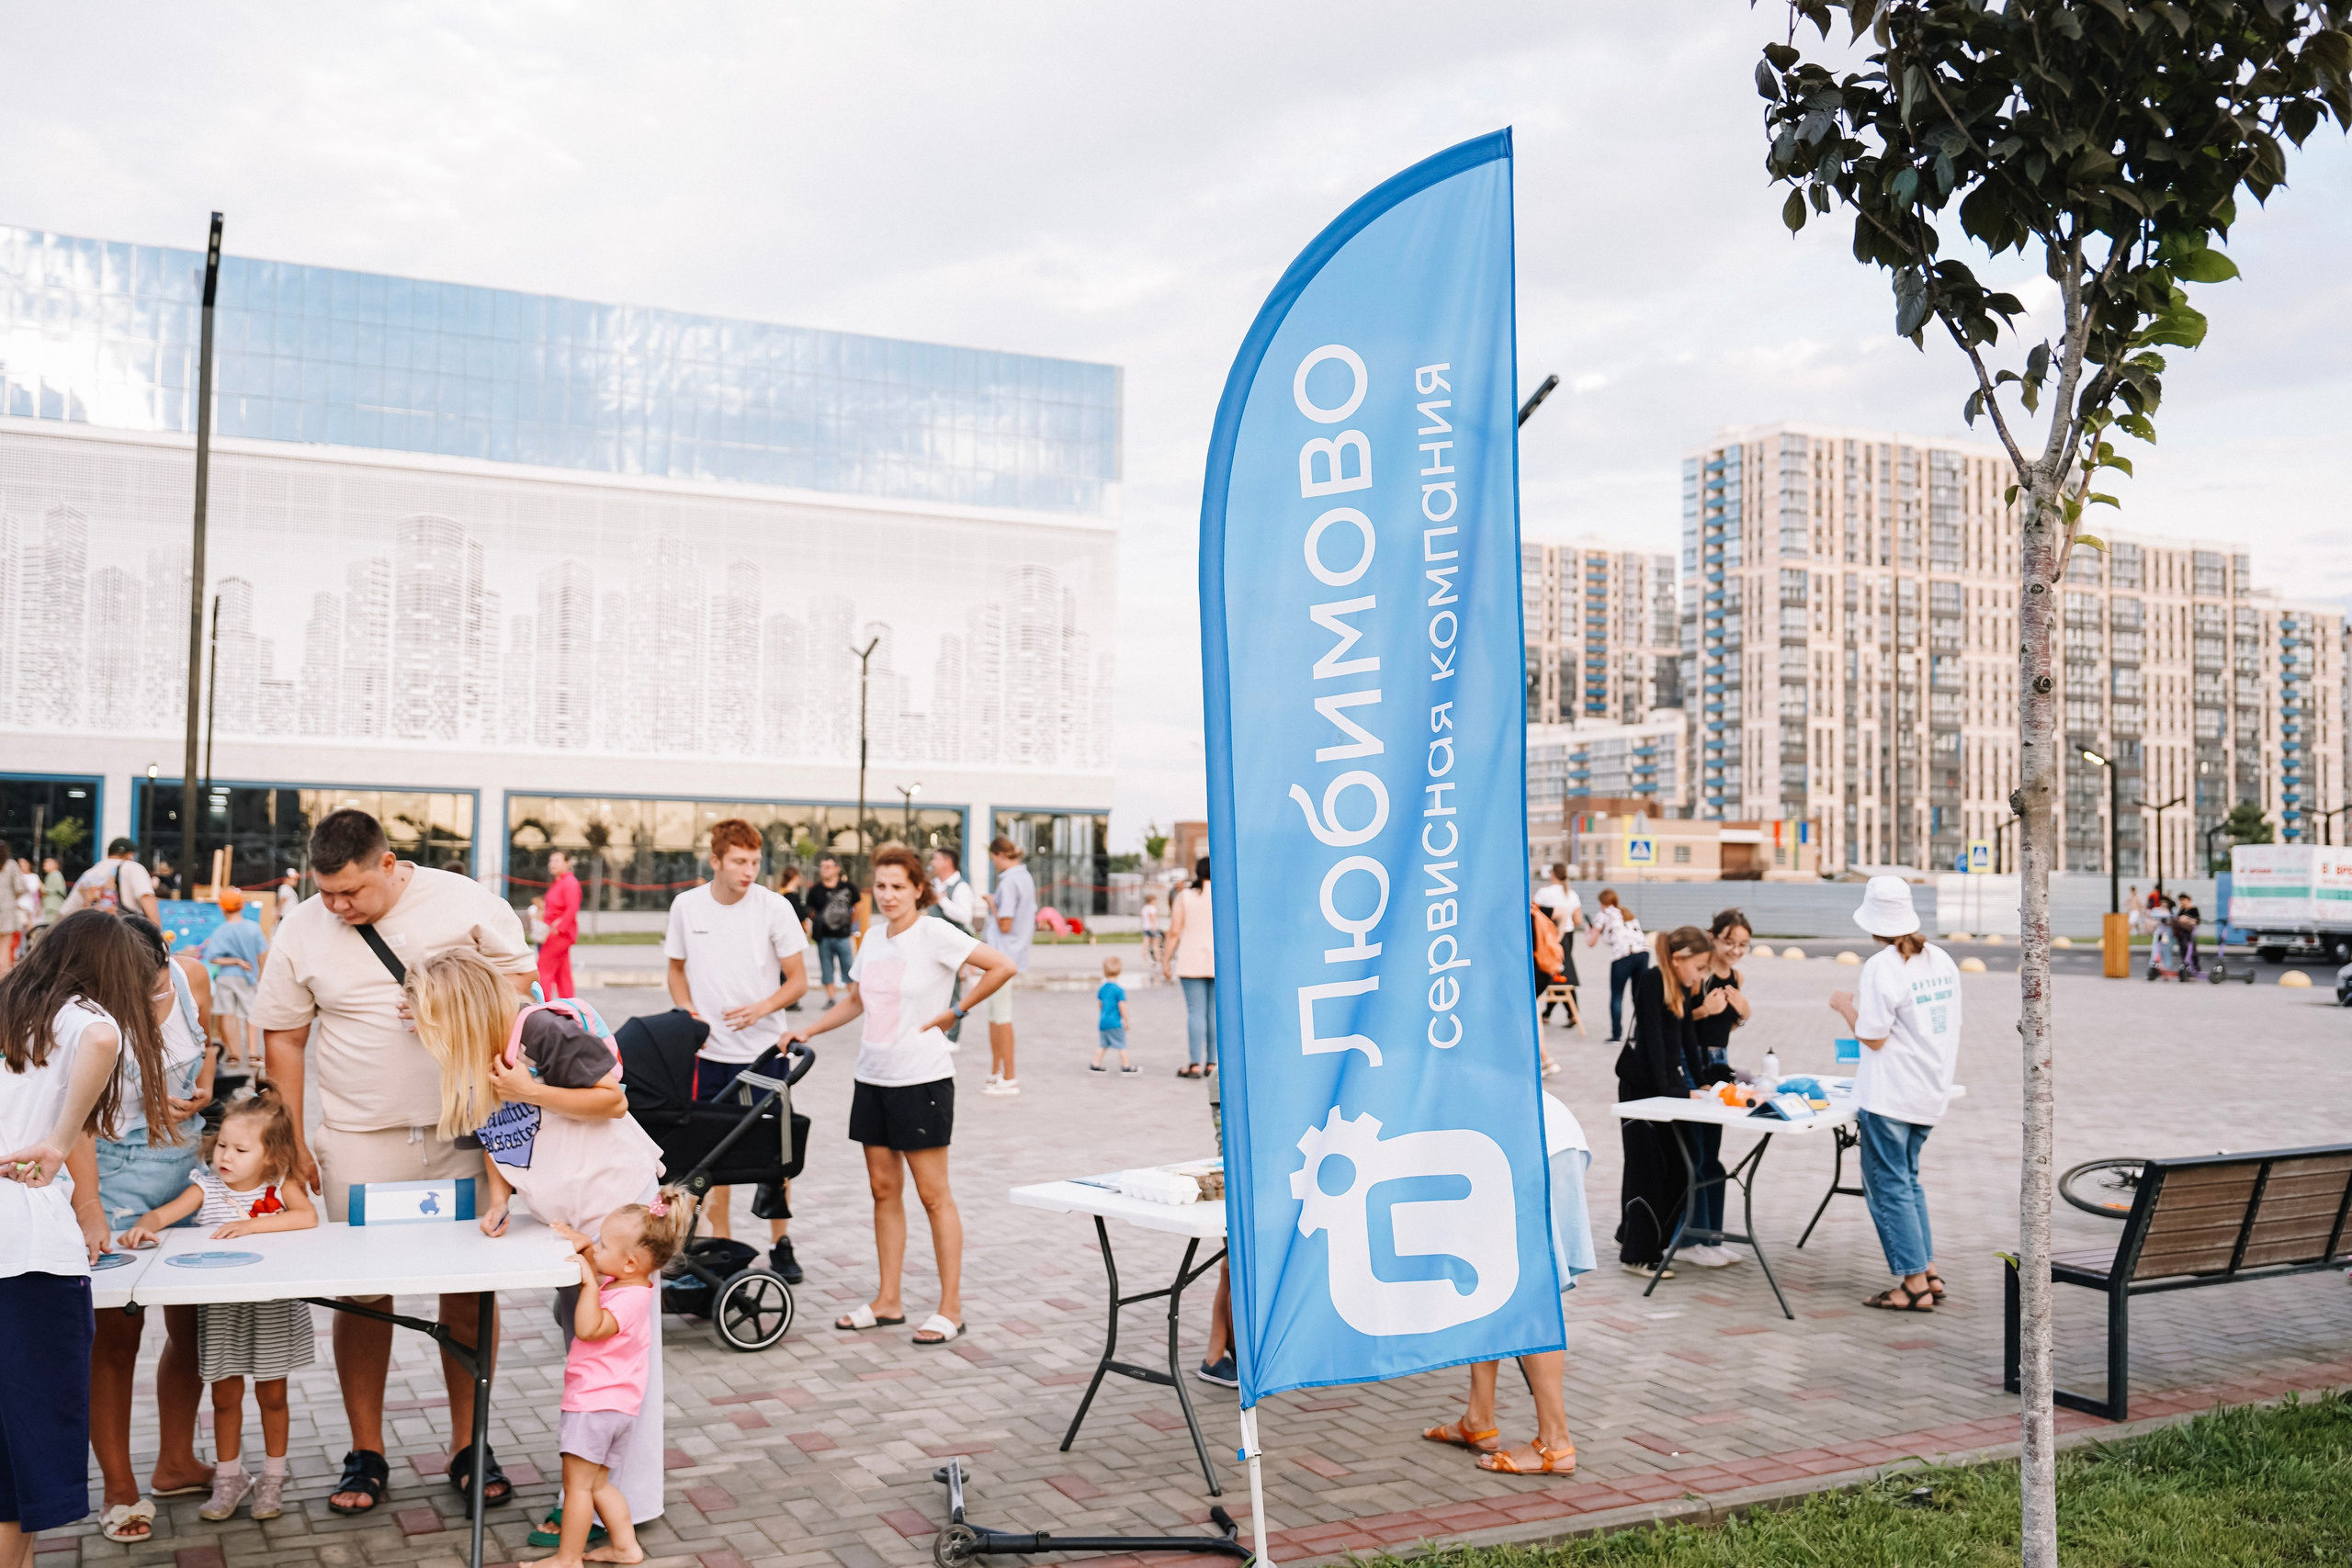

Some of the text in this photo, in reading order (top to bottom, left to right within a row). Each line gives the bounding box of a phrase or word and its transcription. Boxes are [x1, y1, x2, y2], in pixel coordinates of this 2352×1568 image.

[1289, 344, 1390, 1067] Любимово
[1416, 362, 1471, 1049] сервисная компания
[480, 1121, 541, 1154] Disaster
